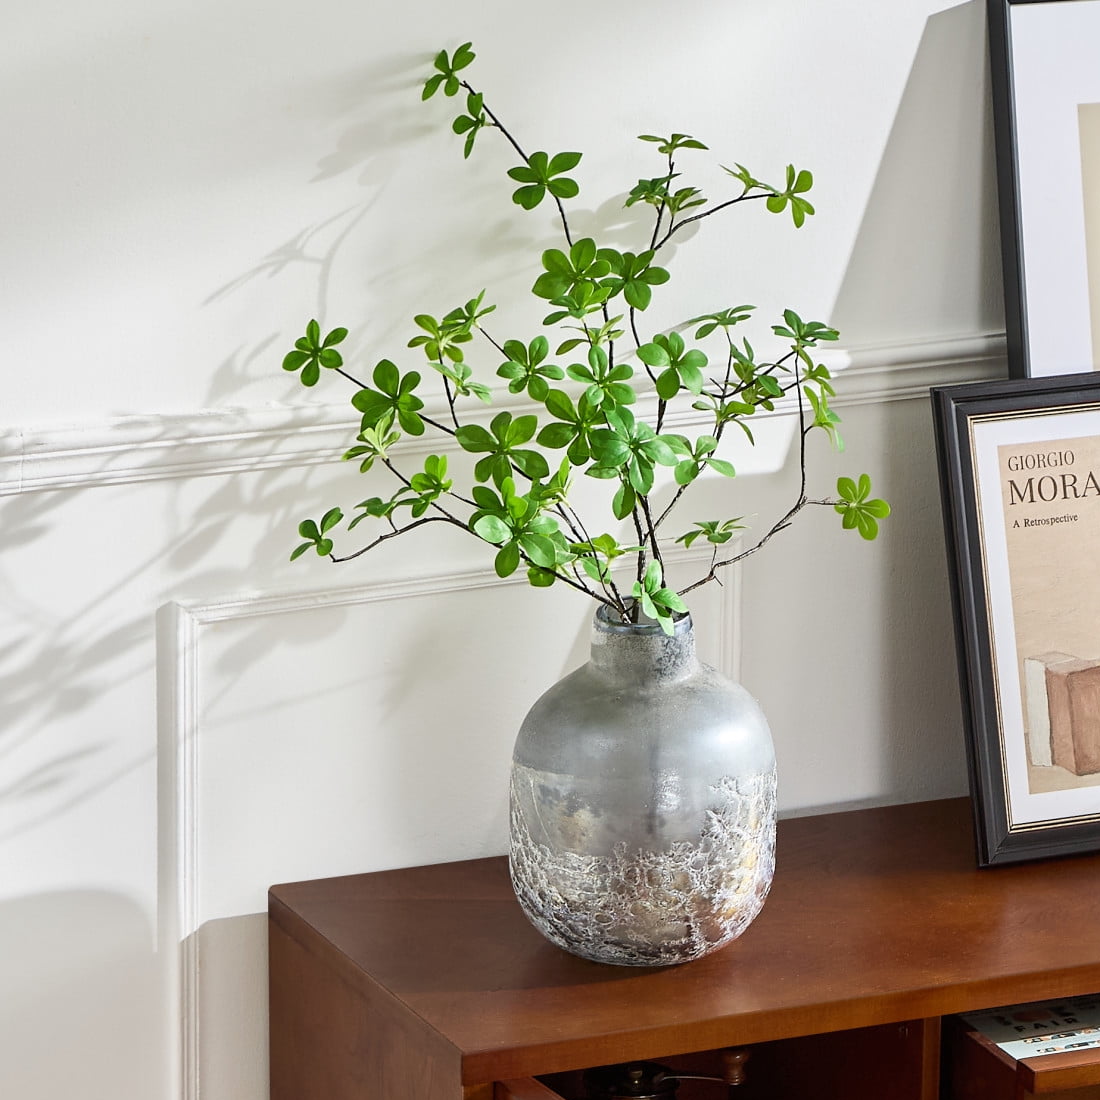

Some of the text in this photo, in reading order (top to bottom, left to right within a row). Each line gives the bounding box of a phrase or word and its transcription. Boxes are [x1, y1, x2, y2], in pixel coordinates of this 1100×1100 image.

[1008, 450, 1075, 472] GIORGIO
[1013, 513, 1078, 528] A Retrospective
[1013, 1017, 1074, 1033] FAIR
